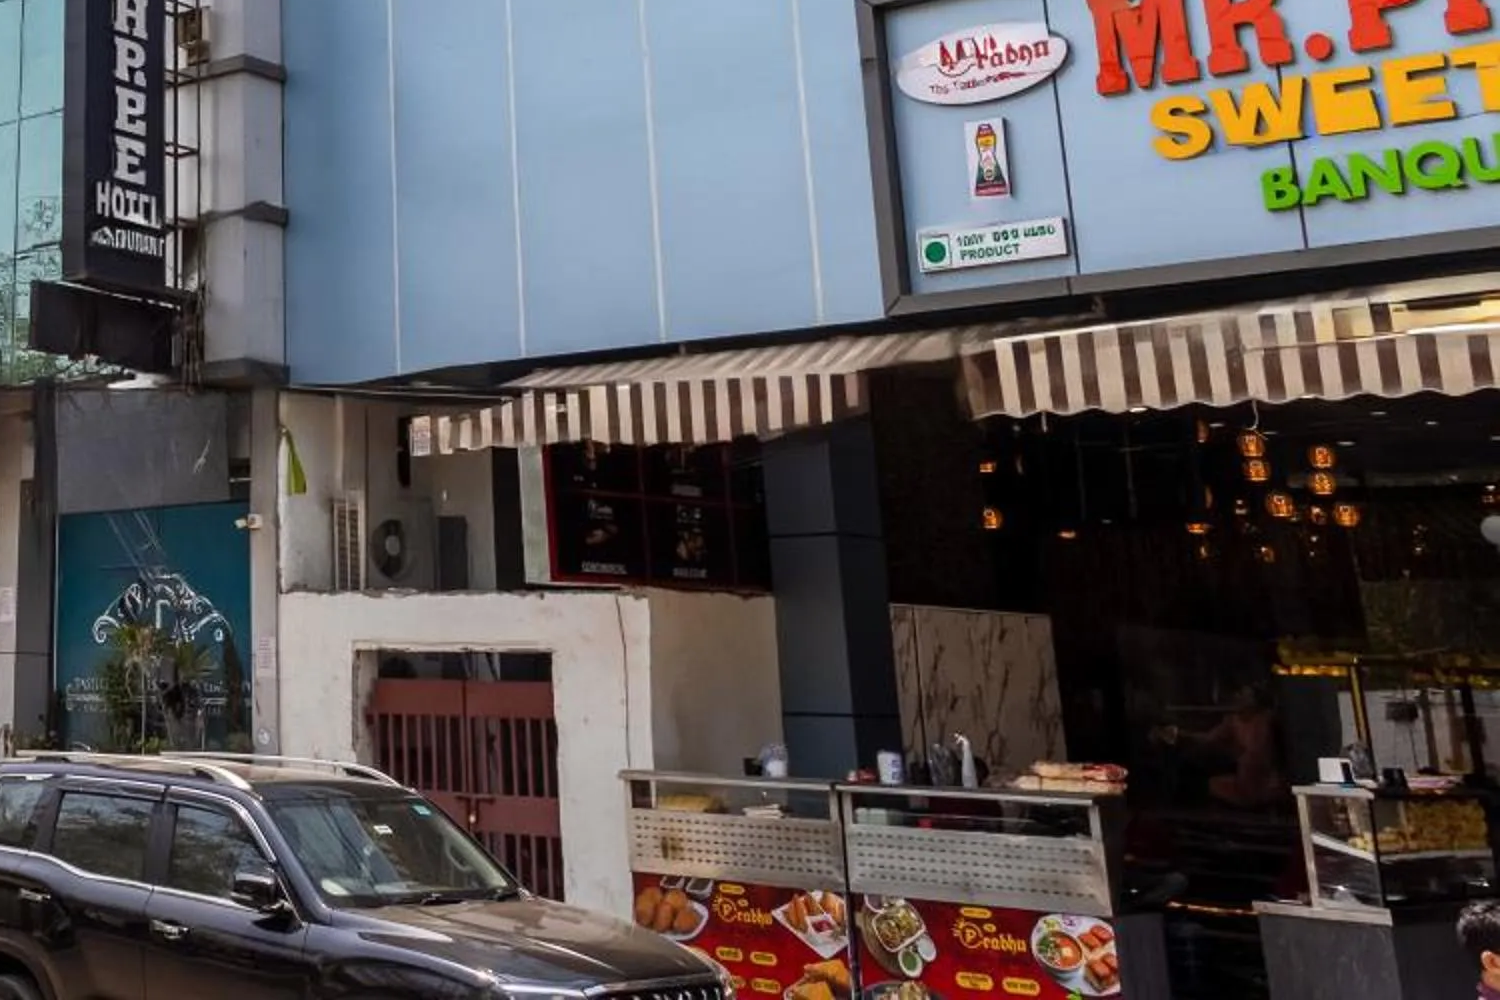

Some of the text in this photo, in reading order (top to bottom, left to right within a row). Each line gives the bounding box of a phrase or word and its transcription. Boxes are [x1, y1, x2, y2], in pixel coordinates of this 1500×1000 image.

[96, 181, 161, 229] HOTEL
[959, 243, 1021, 262] PRODUCT
[958, 922, 1027, 955] Prabhu
